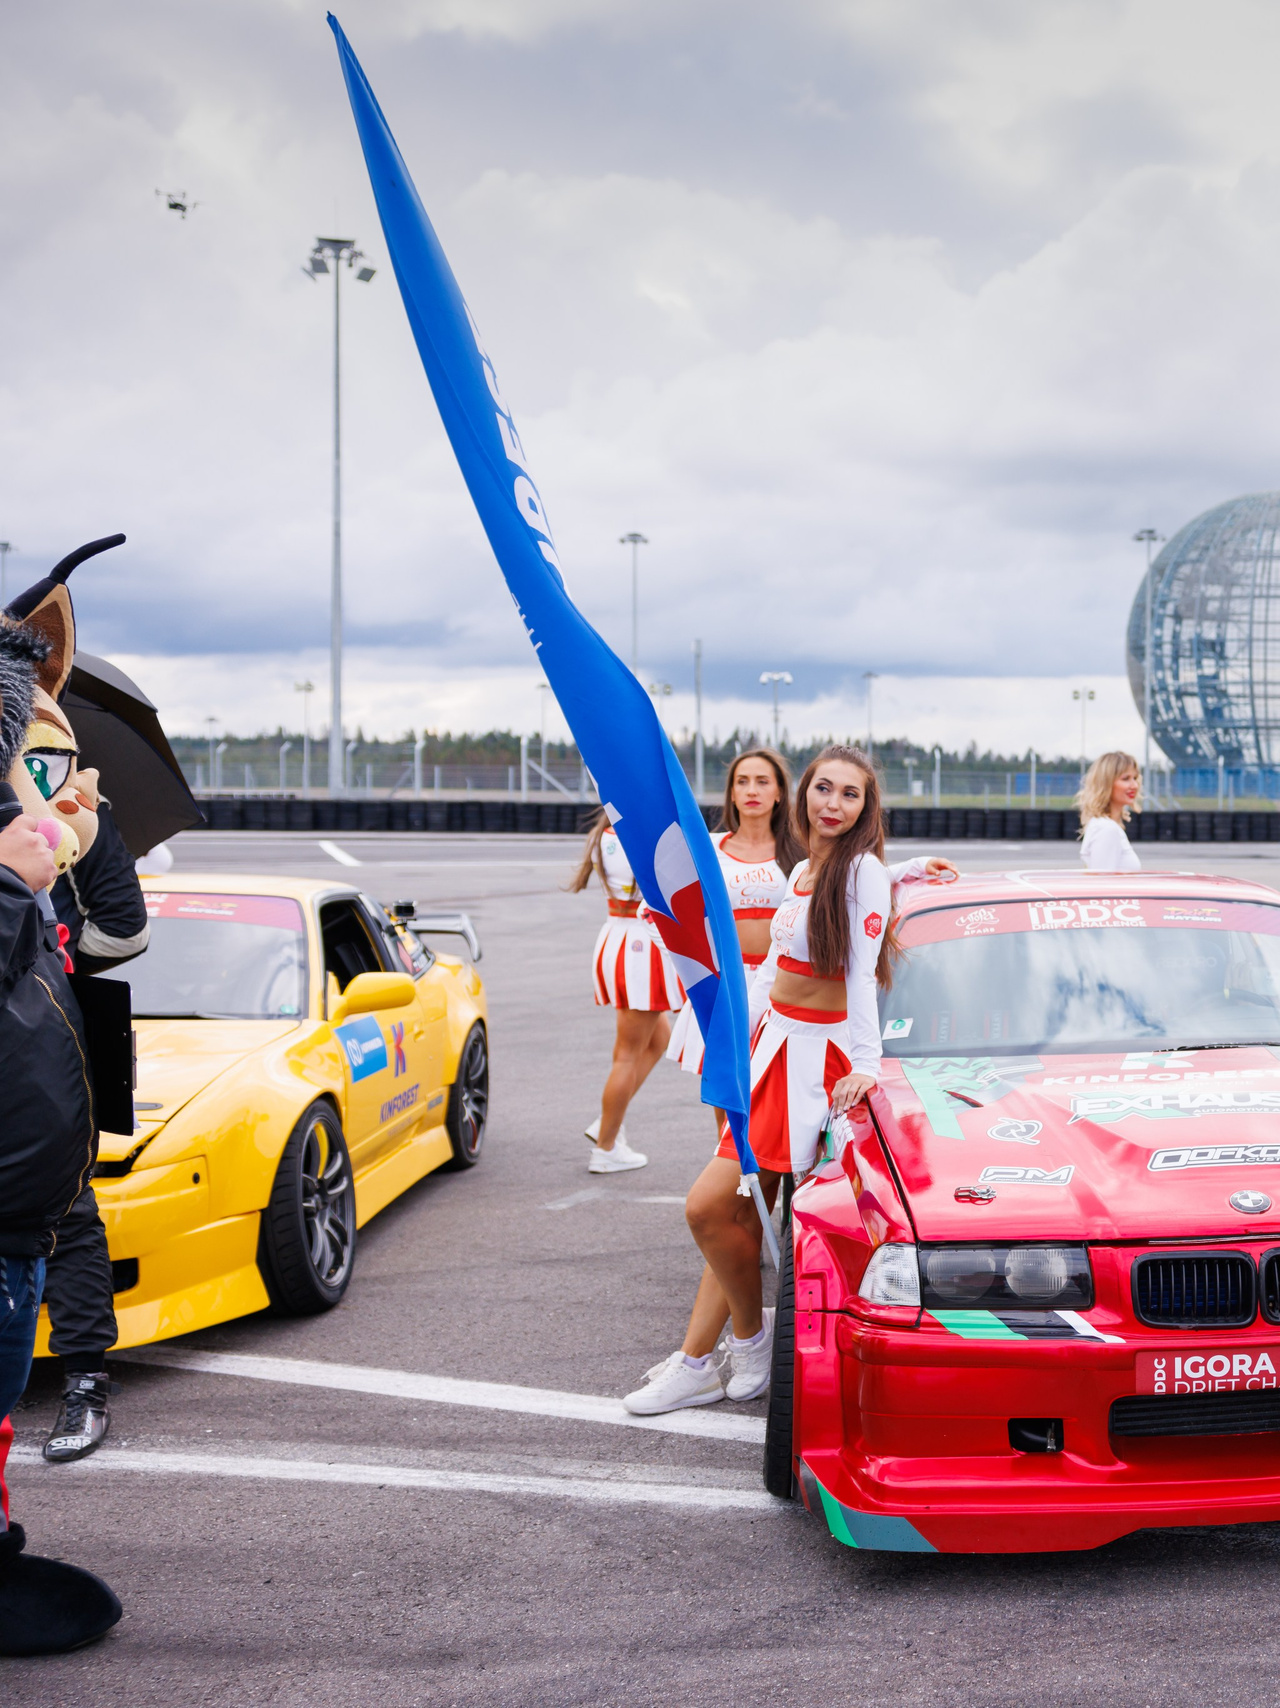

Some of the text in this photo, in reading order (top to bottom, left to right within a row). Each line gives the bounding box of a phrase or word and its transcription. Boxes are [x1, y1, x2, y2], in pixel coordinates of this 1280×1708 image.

[1027, 900, 1080, 908] IGORA
[1028, 904, 1144, 926] IDDC
[1032, 920, 1147, 931] DRIFT CHALLENGE
[1175, 1353, 1276, 1379] IGORA
